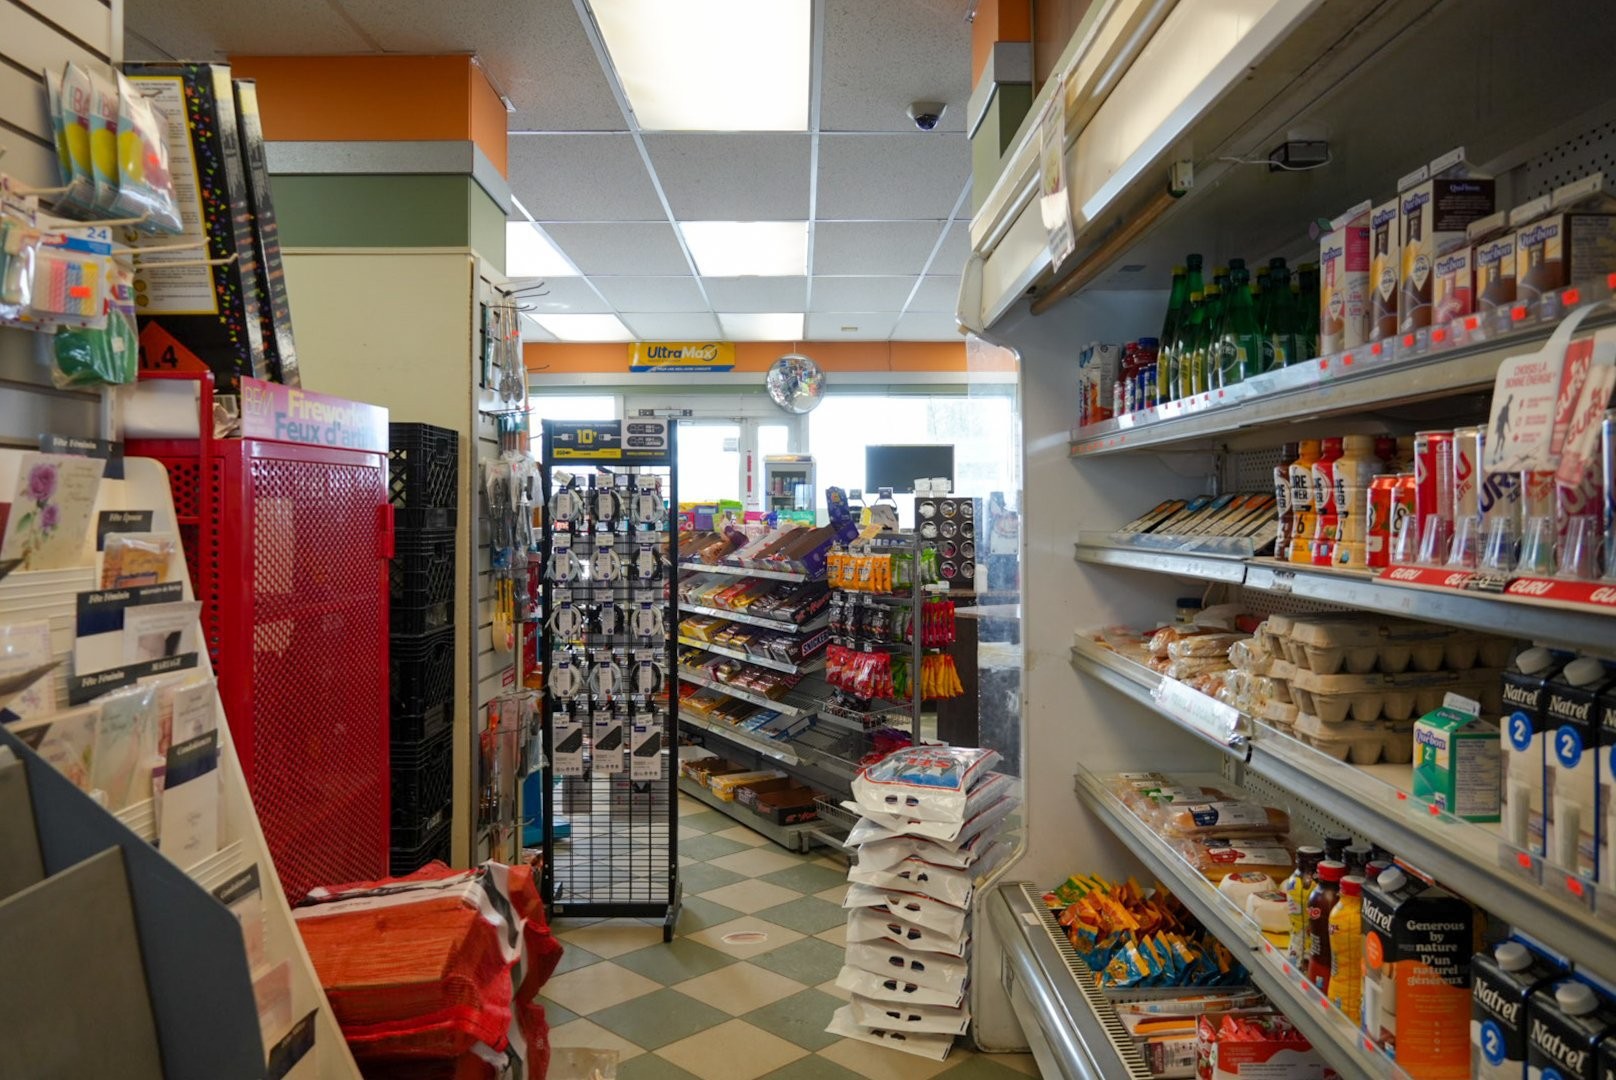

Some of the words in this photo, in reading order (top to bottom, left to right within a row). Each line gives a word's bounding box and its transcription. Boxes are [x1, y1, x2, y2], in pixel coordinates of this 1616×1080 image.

[87, 227, 107, 240] 24
[647, 345, 717, 360] UltraMax
[275, 411, 320, 443] Feux
[1390, 568, 1422, 581] GURU
[1510, 579, 1554, 595] GURU
[1503, 683, 1541, 706] Natrel
[1549, 695, 1592, 720] Natrel
[1513, 720, 1526, 742] 2
[1561, 734, 1575, 759] 2
[1362, 898, 1394, 932] Natrel
[1406, 920, 1465, 931] Generous
[1429, 931, 1444, 943] by
[1415, 943, 1457, 952] nature
[1421, 954, 1450, 965] D'un
[1413, 966, 1459, 975] naturel
[1407, 975, 1464, 986] généreux
[1473, 977, 1521, 1022] Natrel
[1486, 1030, 1499, 1055] 2
[1531, 1019, 1589, 1073] Natrel
